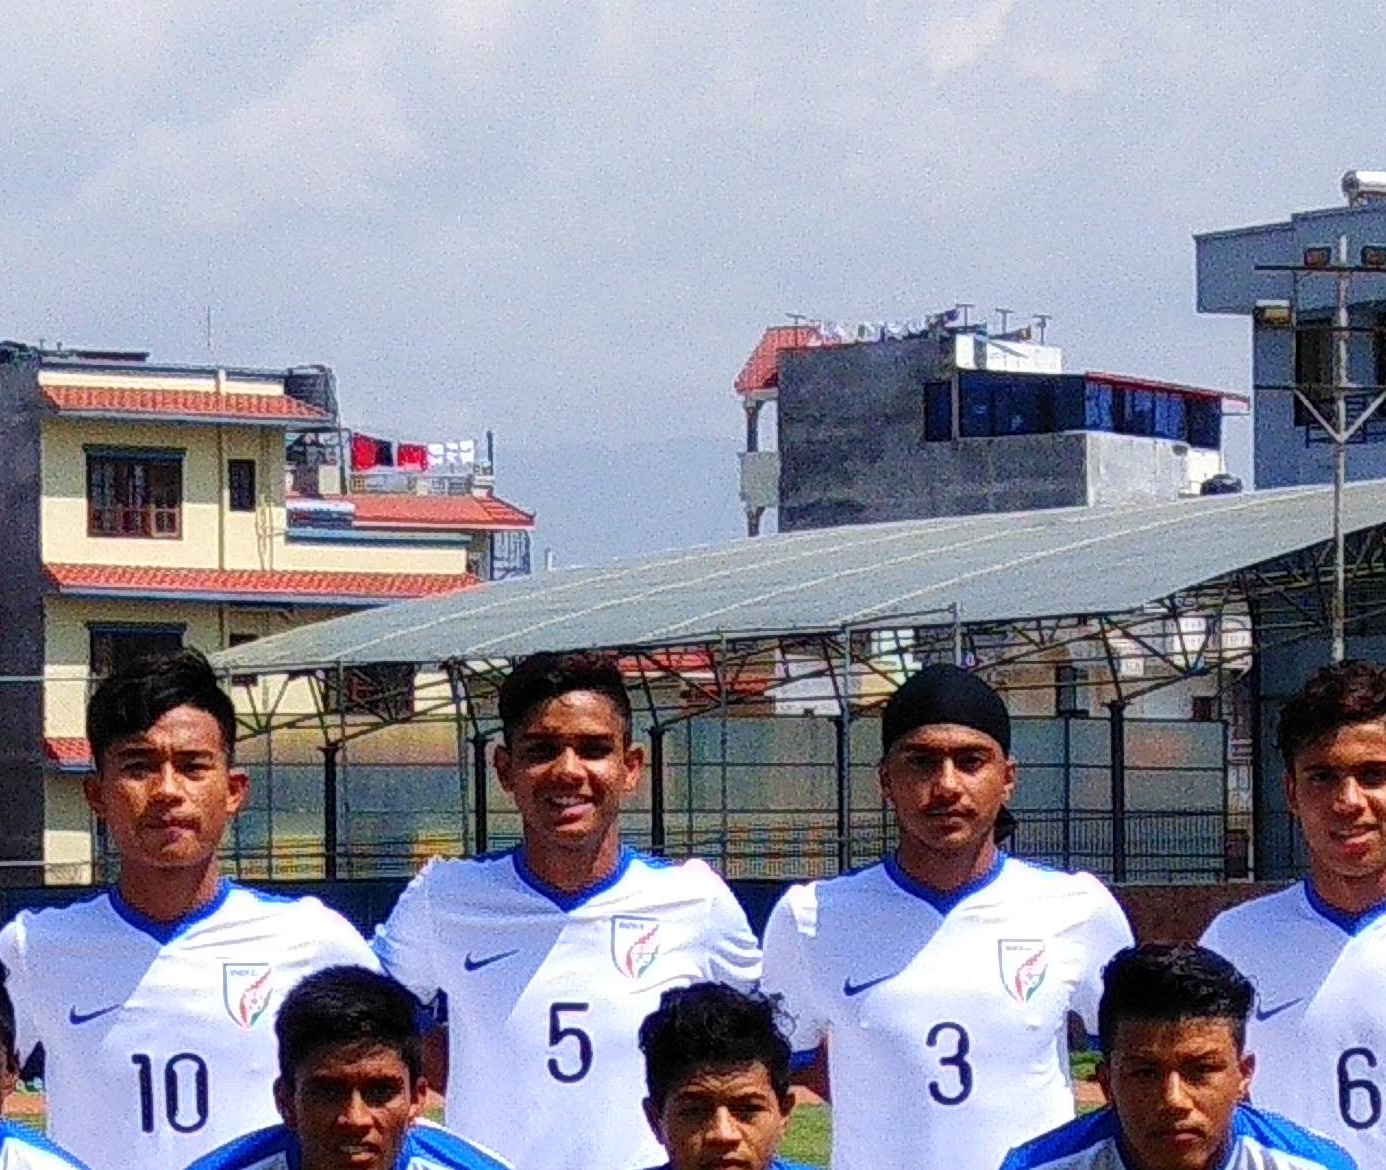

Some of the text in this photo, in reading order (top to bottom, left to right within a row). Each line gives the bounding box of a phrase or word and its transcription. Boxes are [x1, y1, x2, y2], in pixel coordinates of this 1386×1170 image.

[547, 1002, 594, 1083] 5
[926, 1021, 973, 1105] 3
[131, 1052, 209, 1134] 10
[1337, 1047, 1382, 1130] 6
